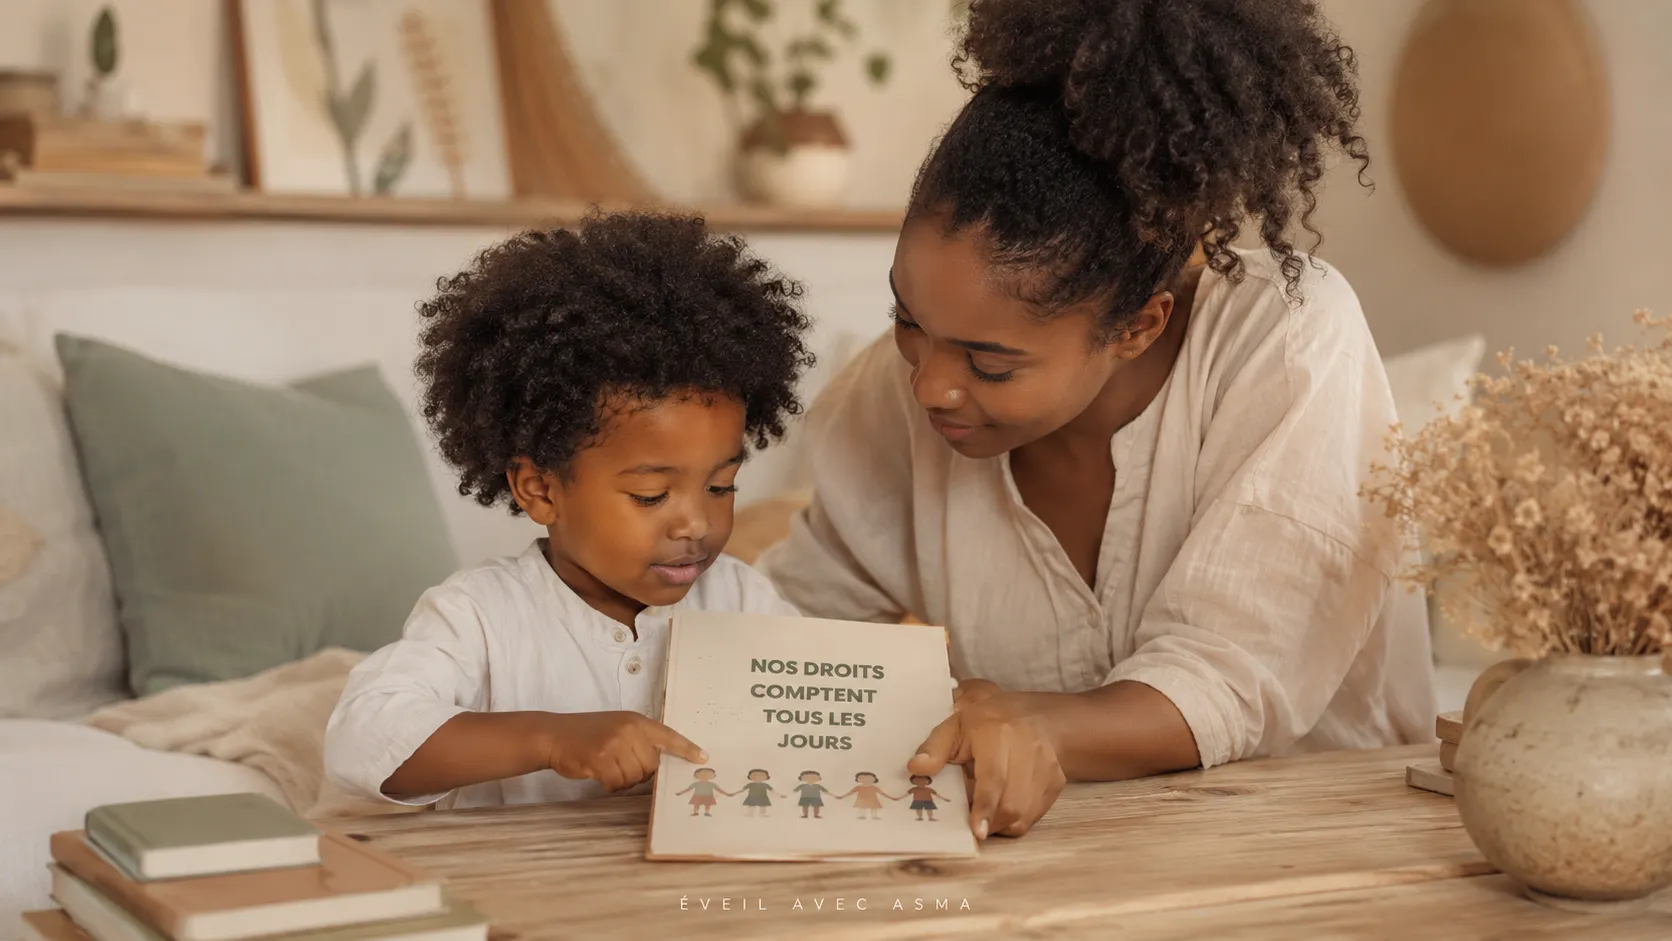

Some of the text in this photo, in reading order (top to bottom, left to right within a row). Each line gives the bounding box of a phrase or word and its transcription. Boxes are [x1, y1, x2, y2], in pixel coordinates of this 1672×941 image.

[751, 658, 885, 679] NOS DROITS
[750, 684, 878, 703] COMPTENT
[763, 709, 866, 727] TOUS LES
[777, 734, 853, 750] JOURS
